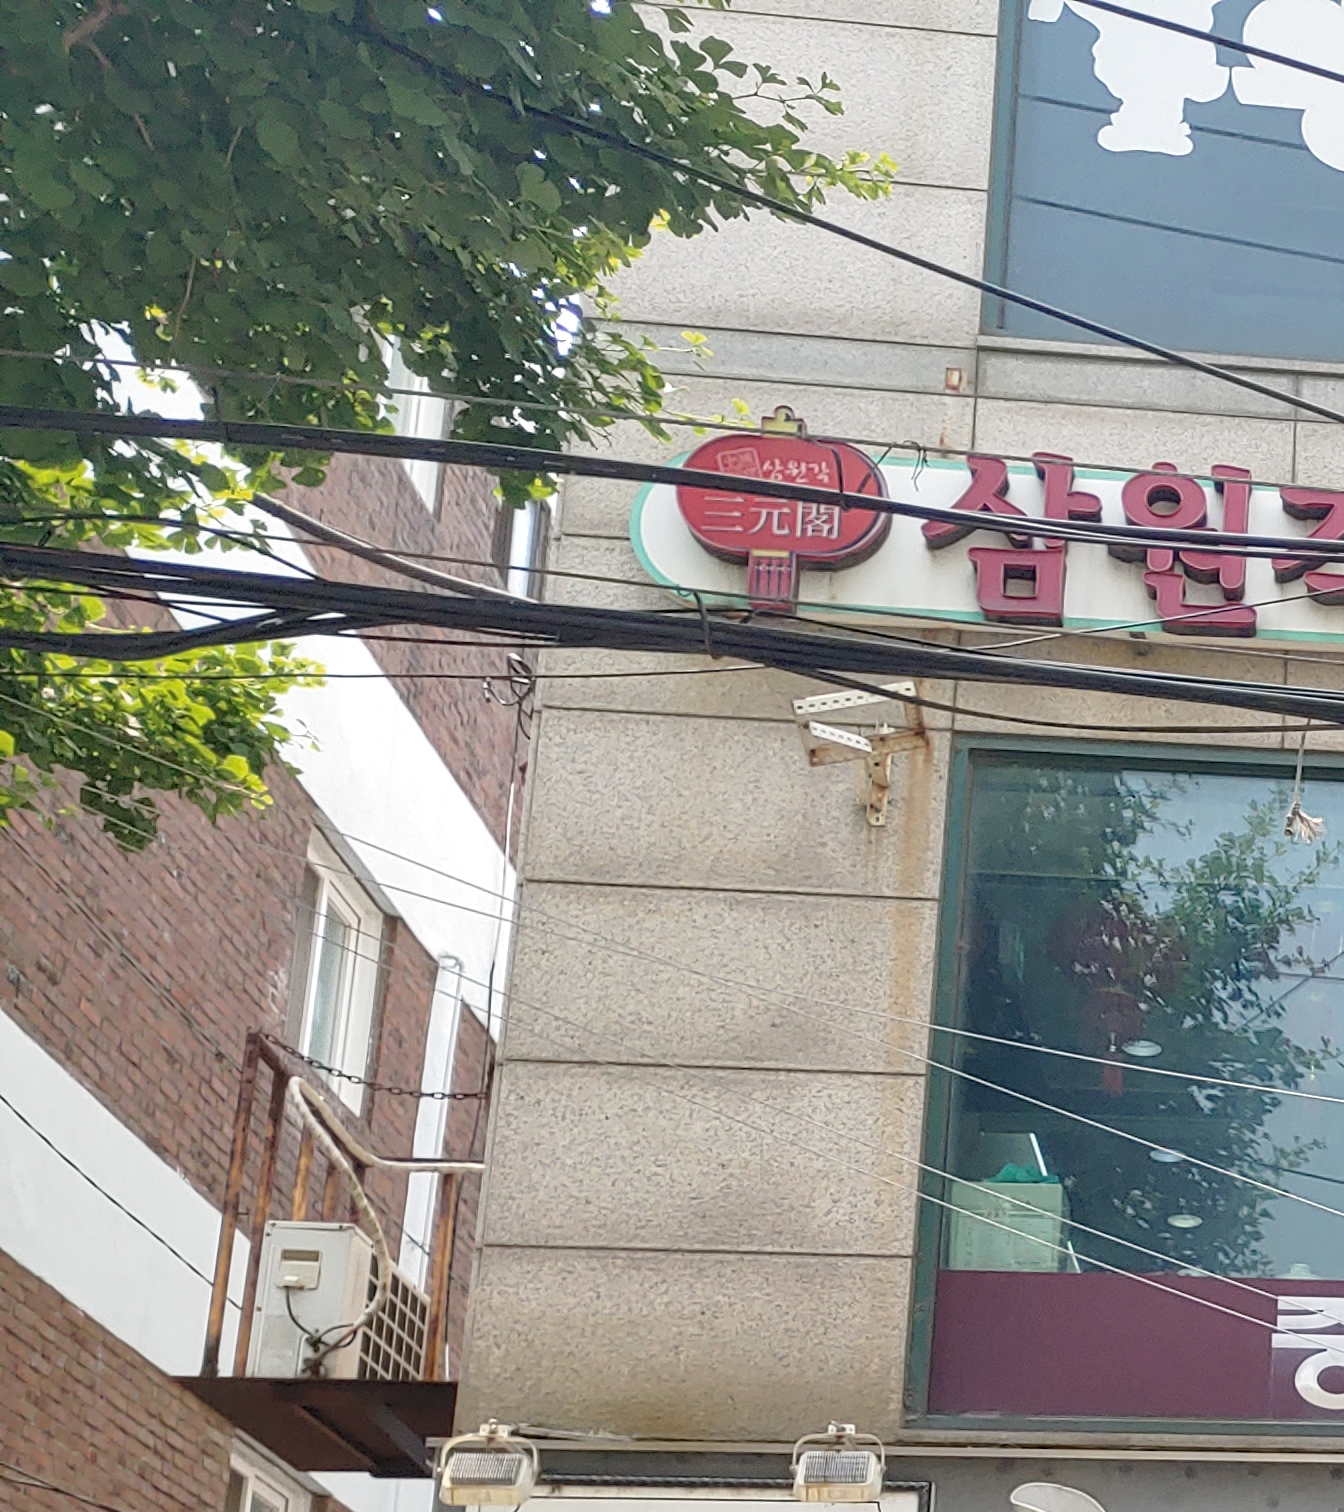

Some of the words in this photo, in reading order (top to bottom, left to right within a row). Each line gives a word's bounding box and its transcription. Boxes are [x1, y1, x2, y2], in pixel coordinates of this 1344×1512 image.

[763, 458, 830, 483] 삼원각
[701, 495, 841, 539] 三元閣
